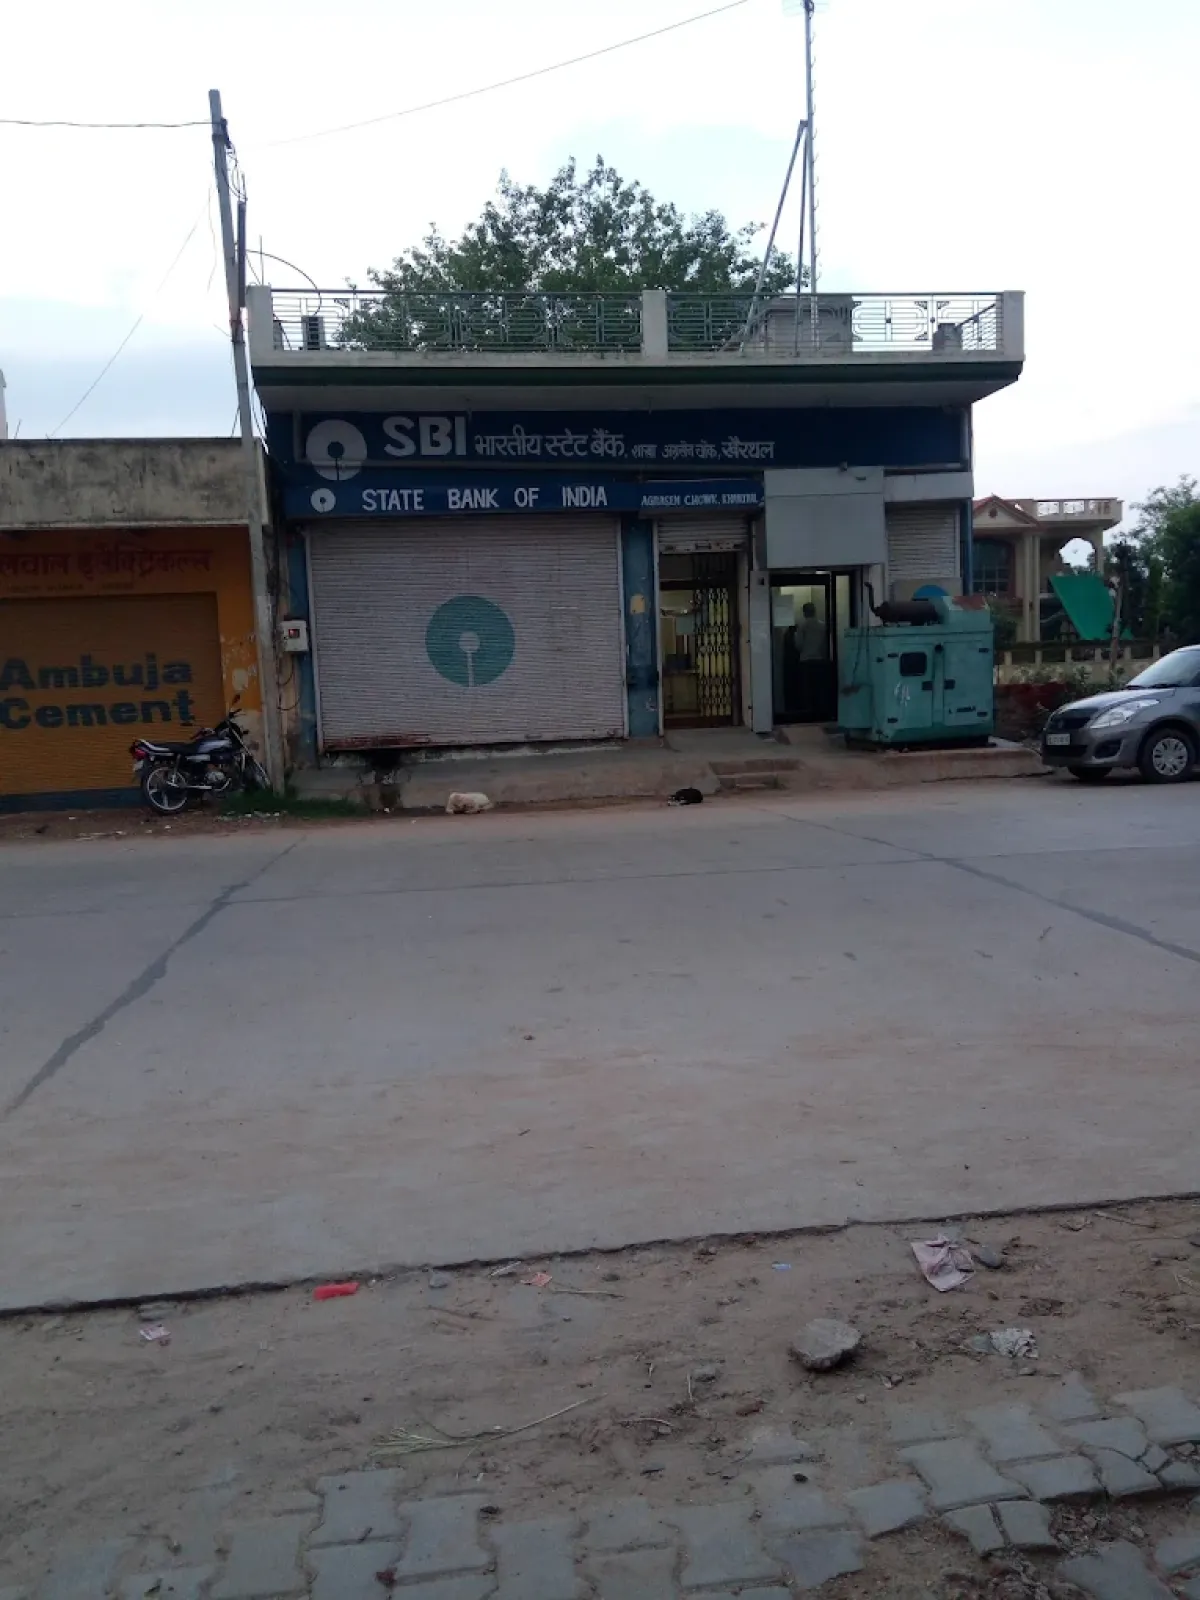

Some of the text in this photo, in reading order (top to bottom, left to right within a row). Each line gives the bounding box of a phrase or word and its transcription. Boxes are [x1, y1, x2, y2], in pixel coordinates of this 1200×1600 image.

[382, 415, 467, 457] SBI
[473, 424, 543, 456] भारतीय
[544, 427, 588, 457] स्टेट
[361, 485, 608, 511] STATE BANK OF INDIA
[0, 652, 192, 690] Ambuja
[0, 690, 195, 729] Cement
